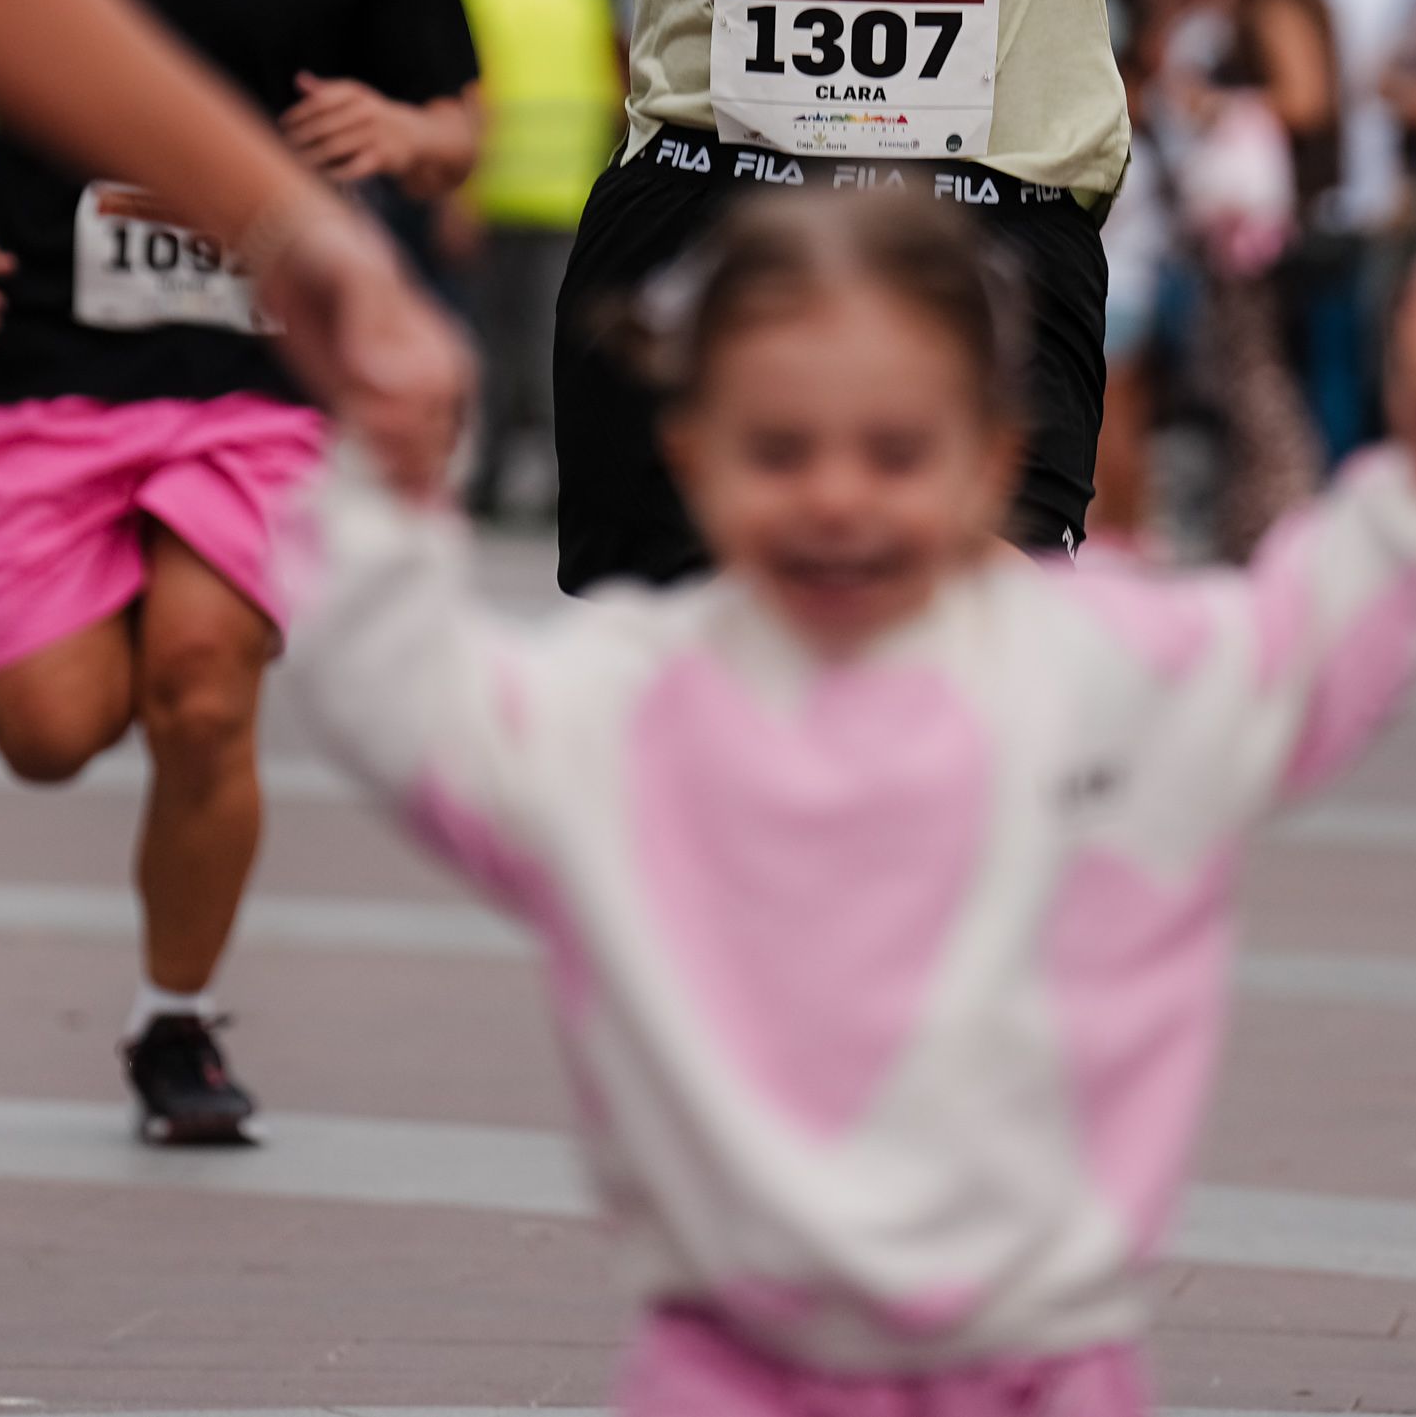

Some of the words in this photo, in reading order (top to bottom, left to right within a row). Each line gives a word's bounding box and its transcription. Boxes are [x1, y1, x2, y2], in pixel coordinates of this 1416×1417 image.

[745, 6, 963, 80] 1307
[815, 85, 887, 102] CLARA
[656, 139, 711, 173] FILA
[734, 152, 804, 186] FILA
[935, 173, 1000, 204] FILA
[106, 222, 253, 278] 109
